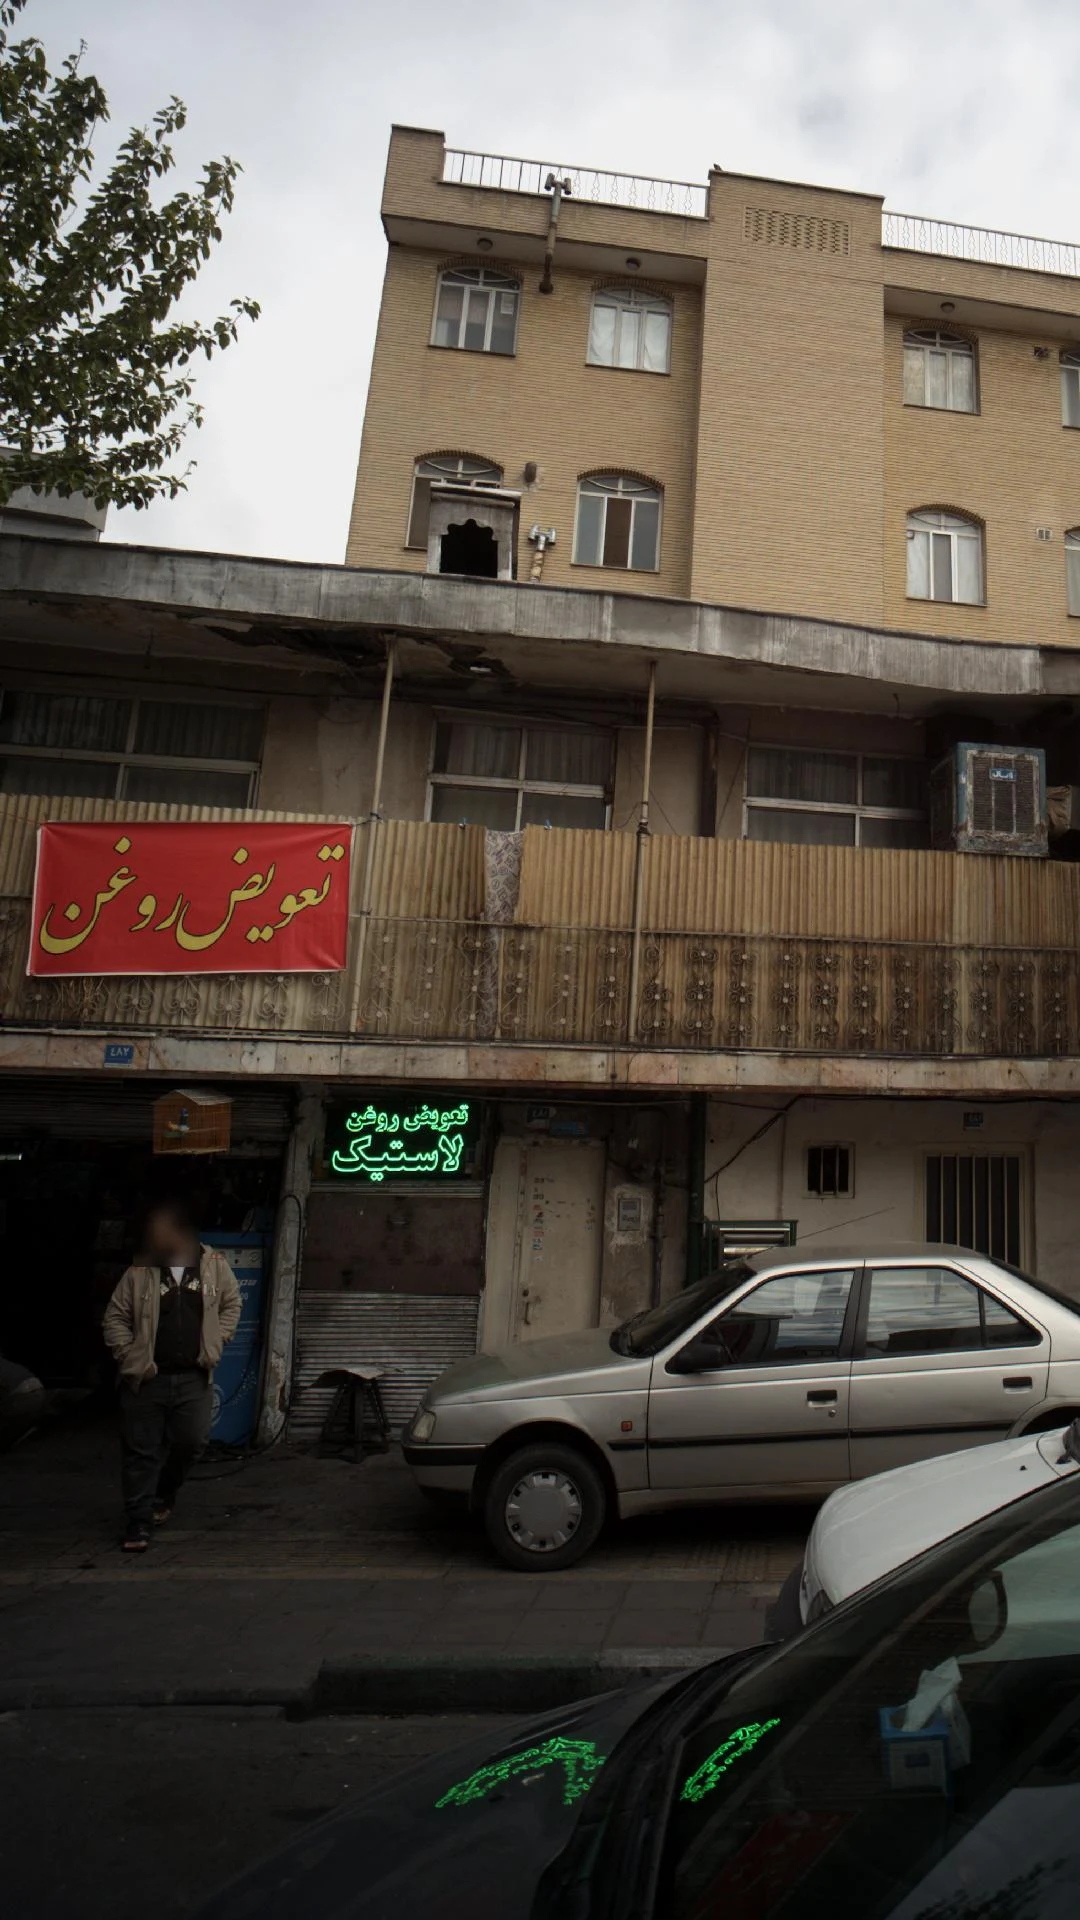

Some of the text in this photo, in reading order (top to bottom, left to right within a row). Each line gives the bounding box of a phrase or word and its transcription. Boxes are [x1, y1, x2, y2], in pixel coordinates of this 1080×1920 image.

[39, 836, 346, 955] تعویض روغن
[345, 1102, 470, 1133] تعویض روغن
[331, 1133, 466, 1183] لاستیک
